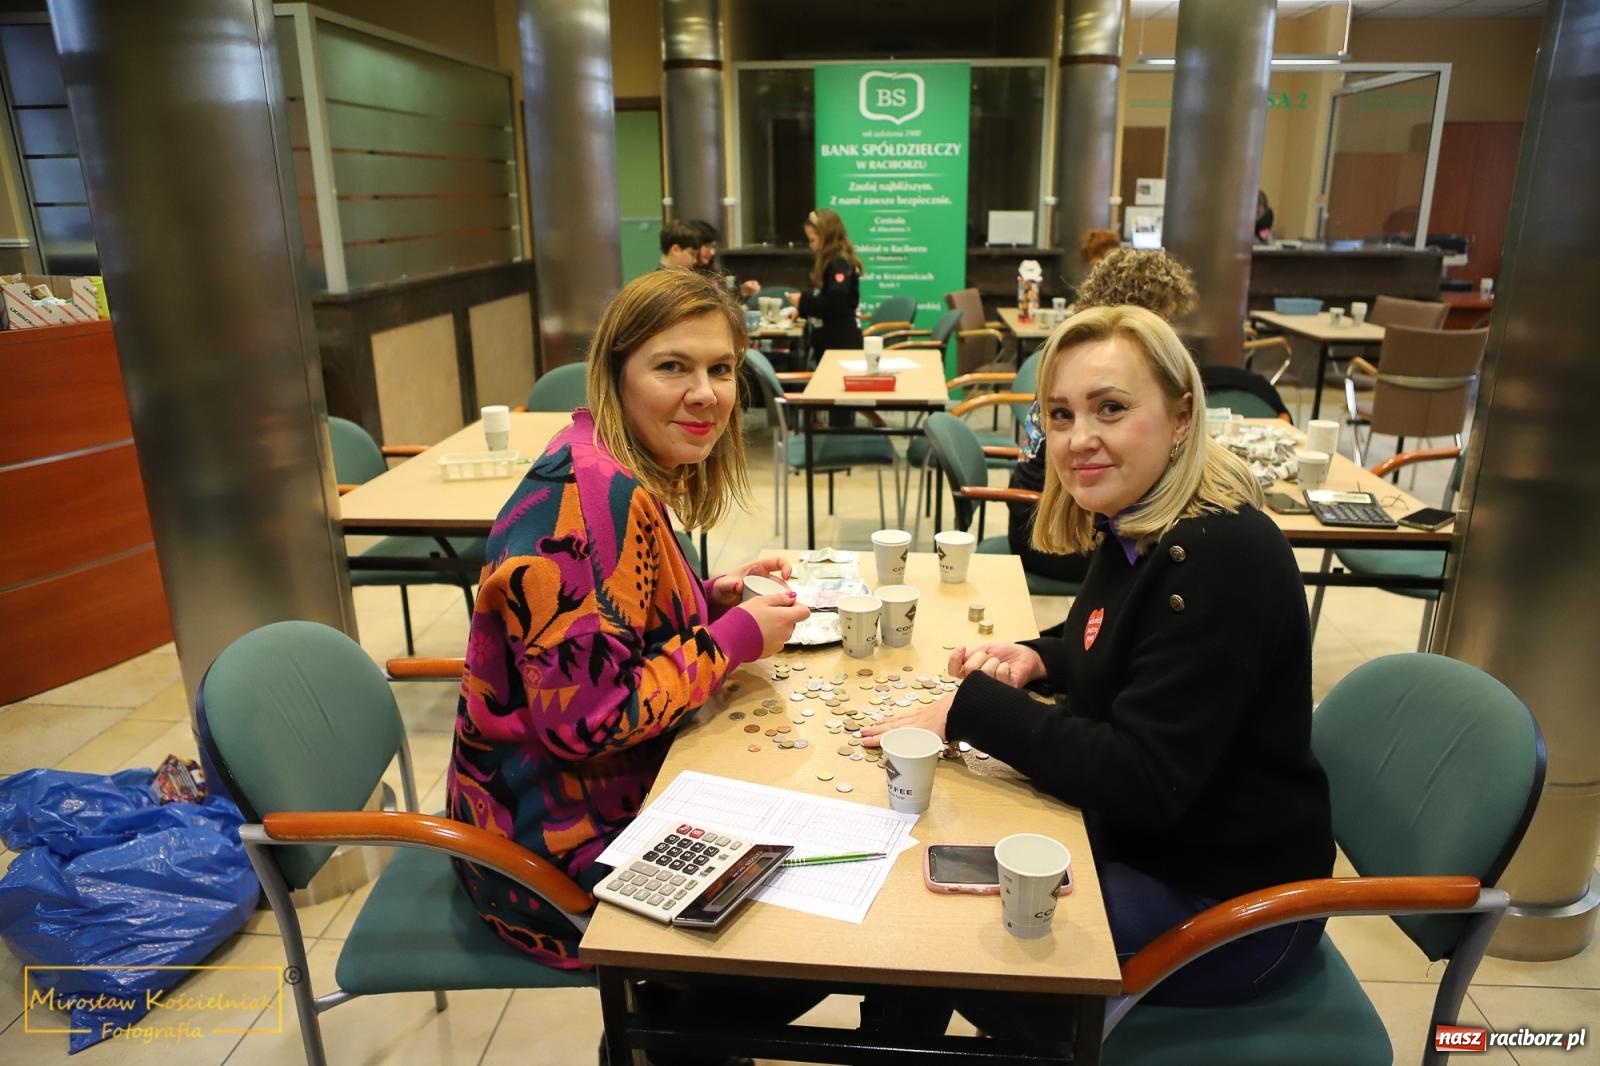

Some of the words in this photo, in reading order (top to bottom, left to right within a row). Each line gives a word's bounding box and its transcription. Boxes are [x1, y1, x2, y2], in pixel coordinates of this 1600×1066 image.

[876, 88, 906, 107] BS
[821, 144, 859, 157] BANK
[862, 140, 962, 157] SPÓŁDZIELCZY
[856, 160, 866, 169] W
[868, 160, 928, 169] RACIBORZU
[830, 196, 837, 205] Z
[838, 196, 861, 205] nami
